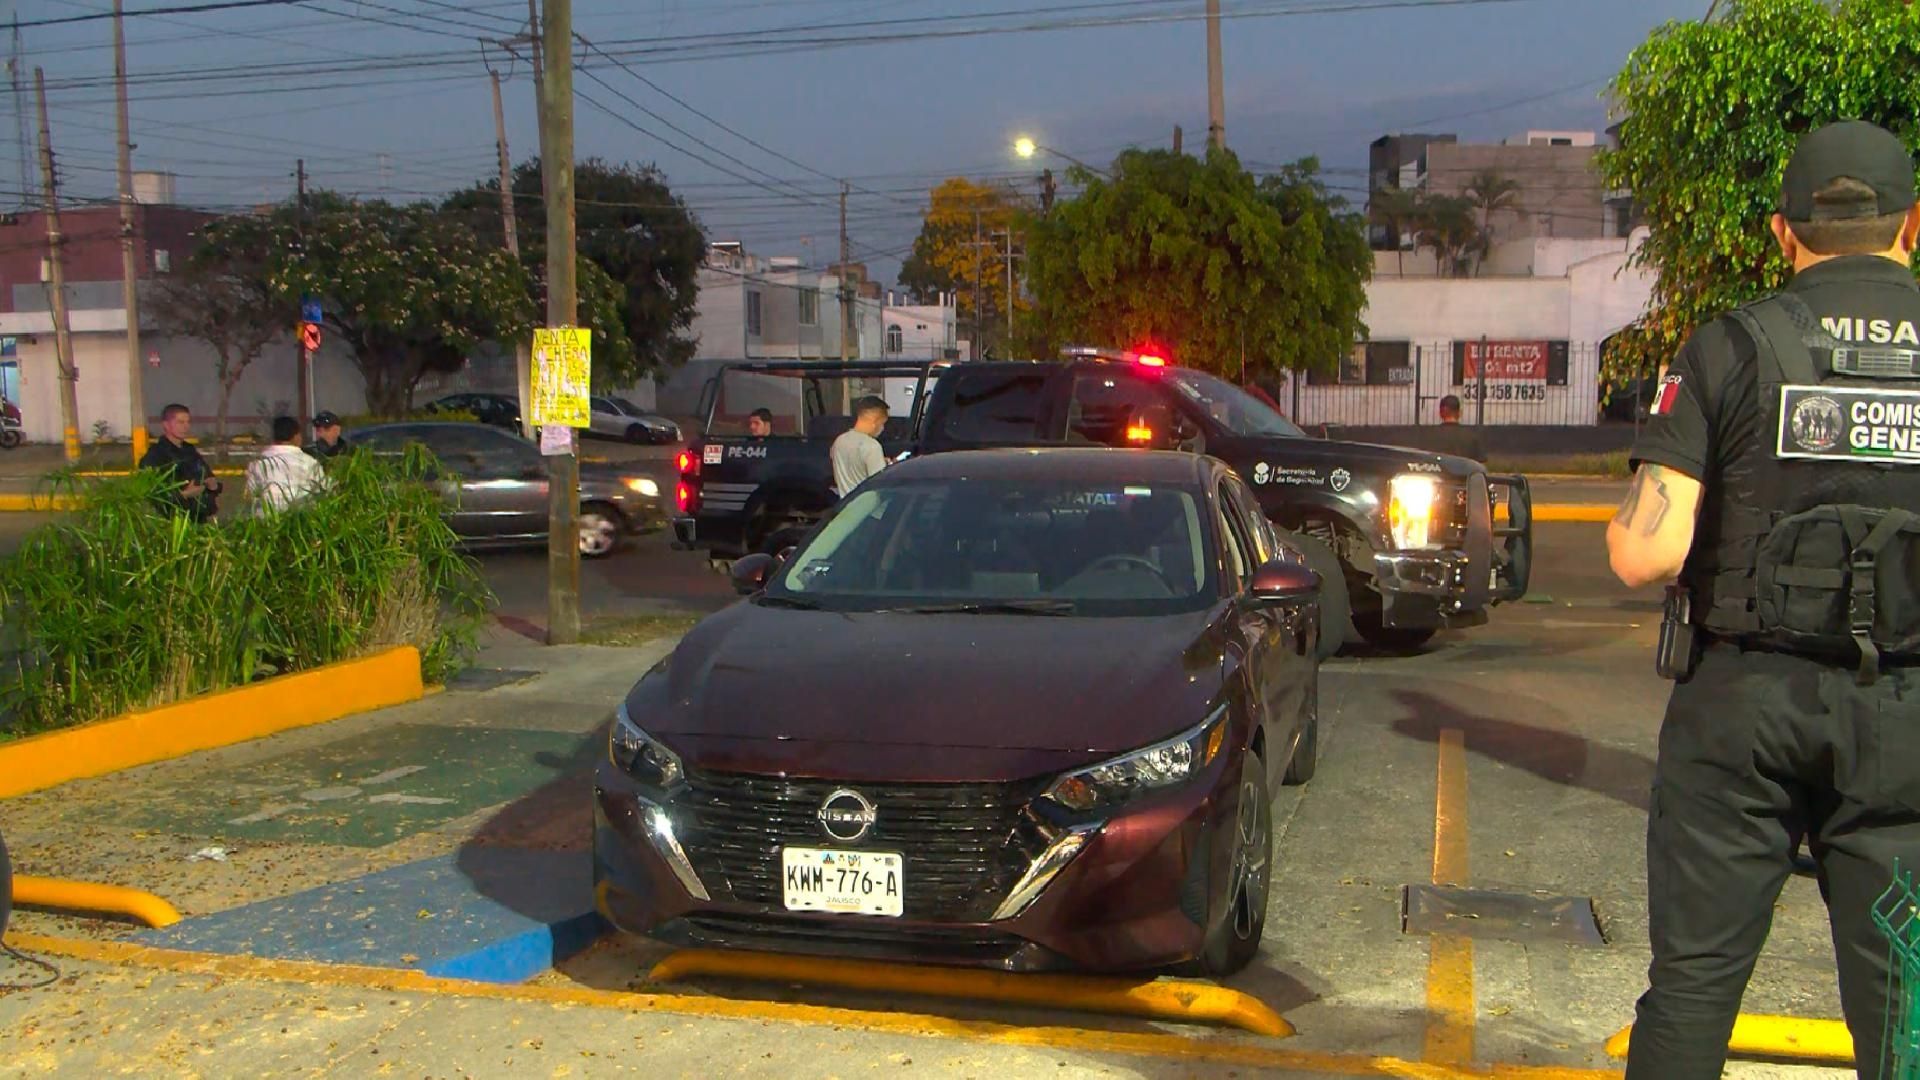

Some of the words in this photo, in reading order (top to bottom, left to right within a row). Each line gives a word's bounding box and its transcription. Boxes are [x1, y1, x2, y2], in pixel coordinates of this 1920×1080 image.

[534, 329, 579, 345] VENTA
[1494, 345, 1541, 359] RENTA
[728, 446, 767, 458] PE-044
[818, 810, 876, 823] NISSAN
[787, 865, 898, 897] KWM-776-A
[826, 896, 862, 904] JALISCO
